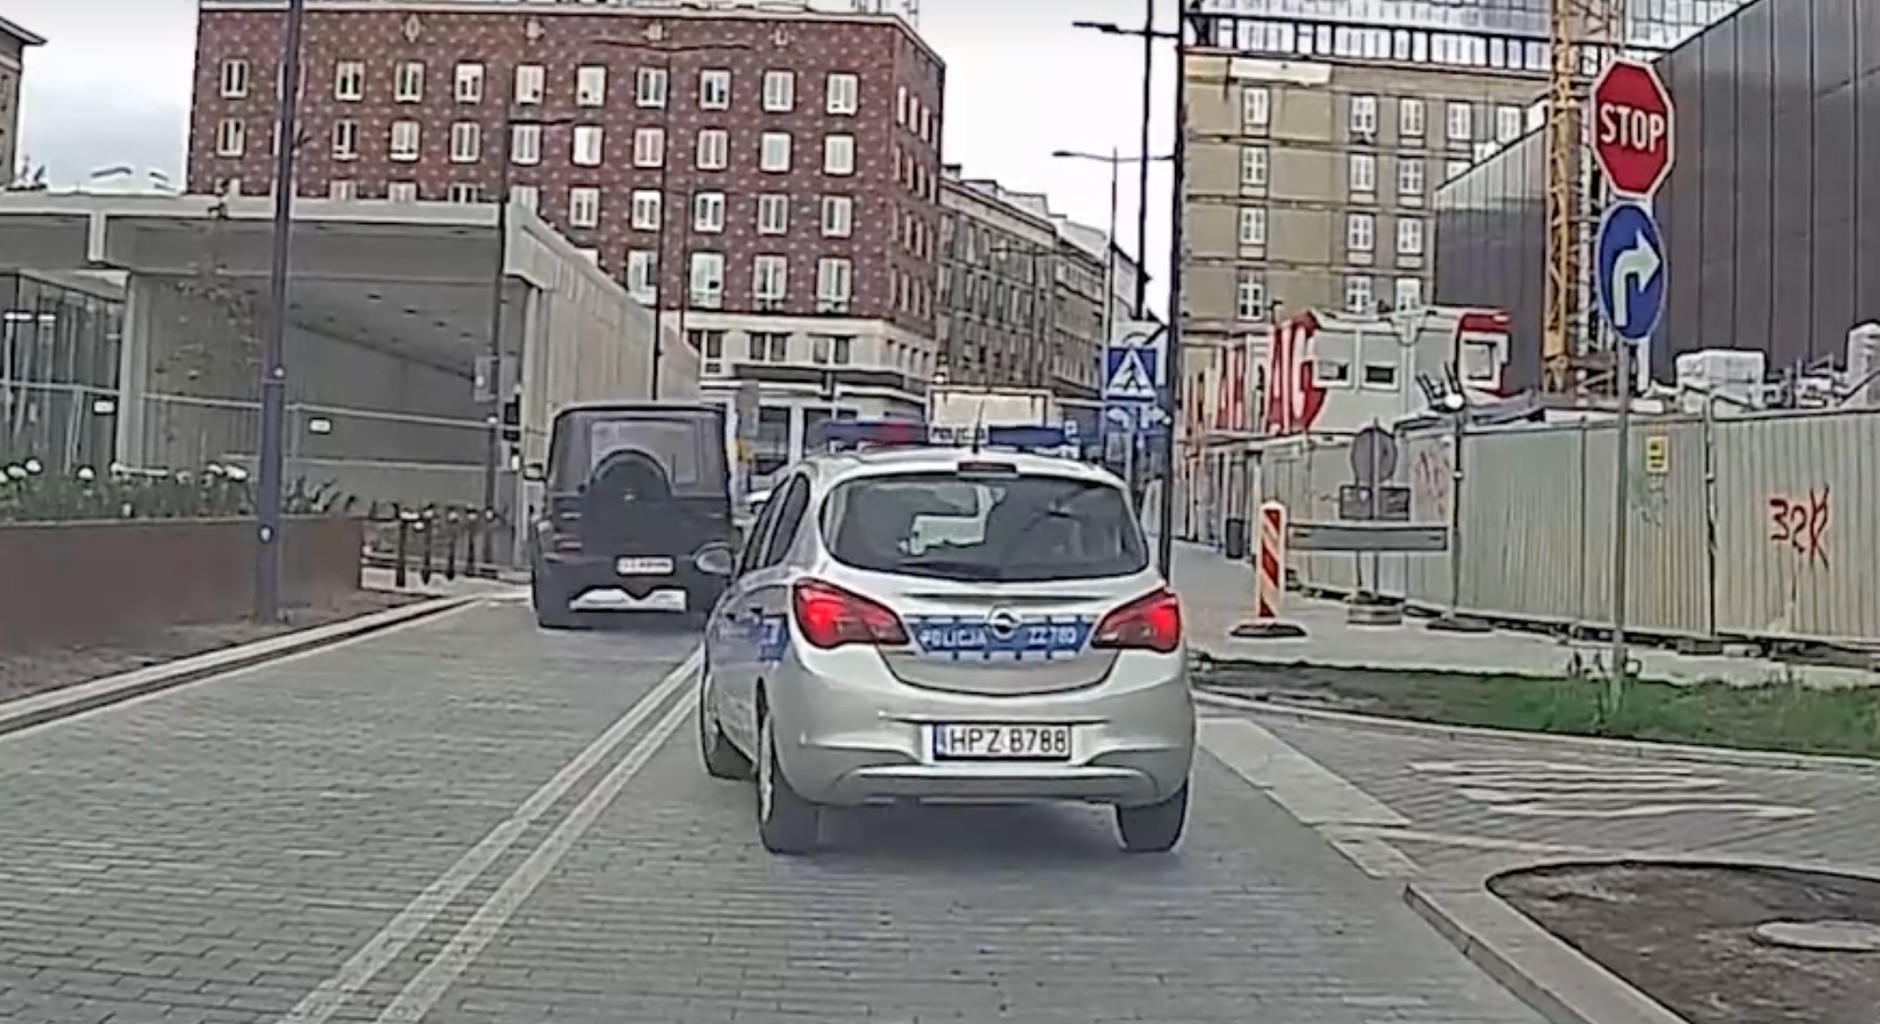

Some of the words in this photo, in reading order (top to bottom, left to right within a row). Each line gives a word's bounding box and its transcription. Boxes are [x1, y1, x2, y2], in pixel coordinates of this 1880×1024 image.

[1600, 102, 1665, 153] STOP
[918, 628, 988, 647] POLICJA
[950, 727, 1001, 753] HPZ
[1009, 727, 1067, 753] B788
